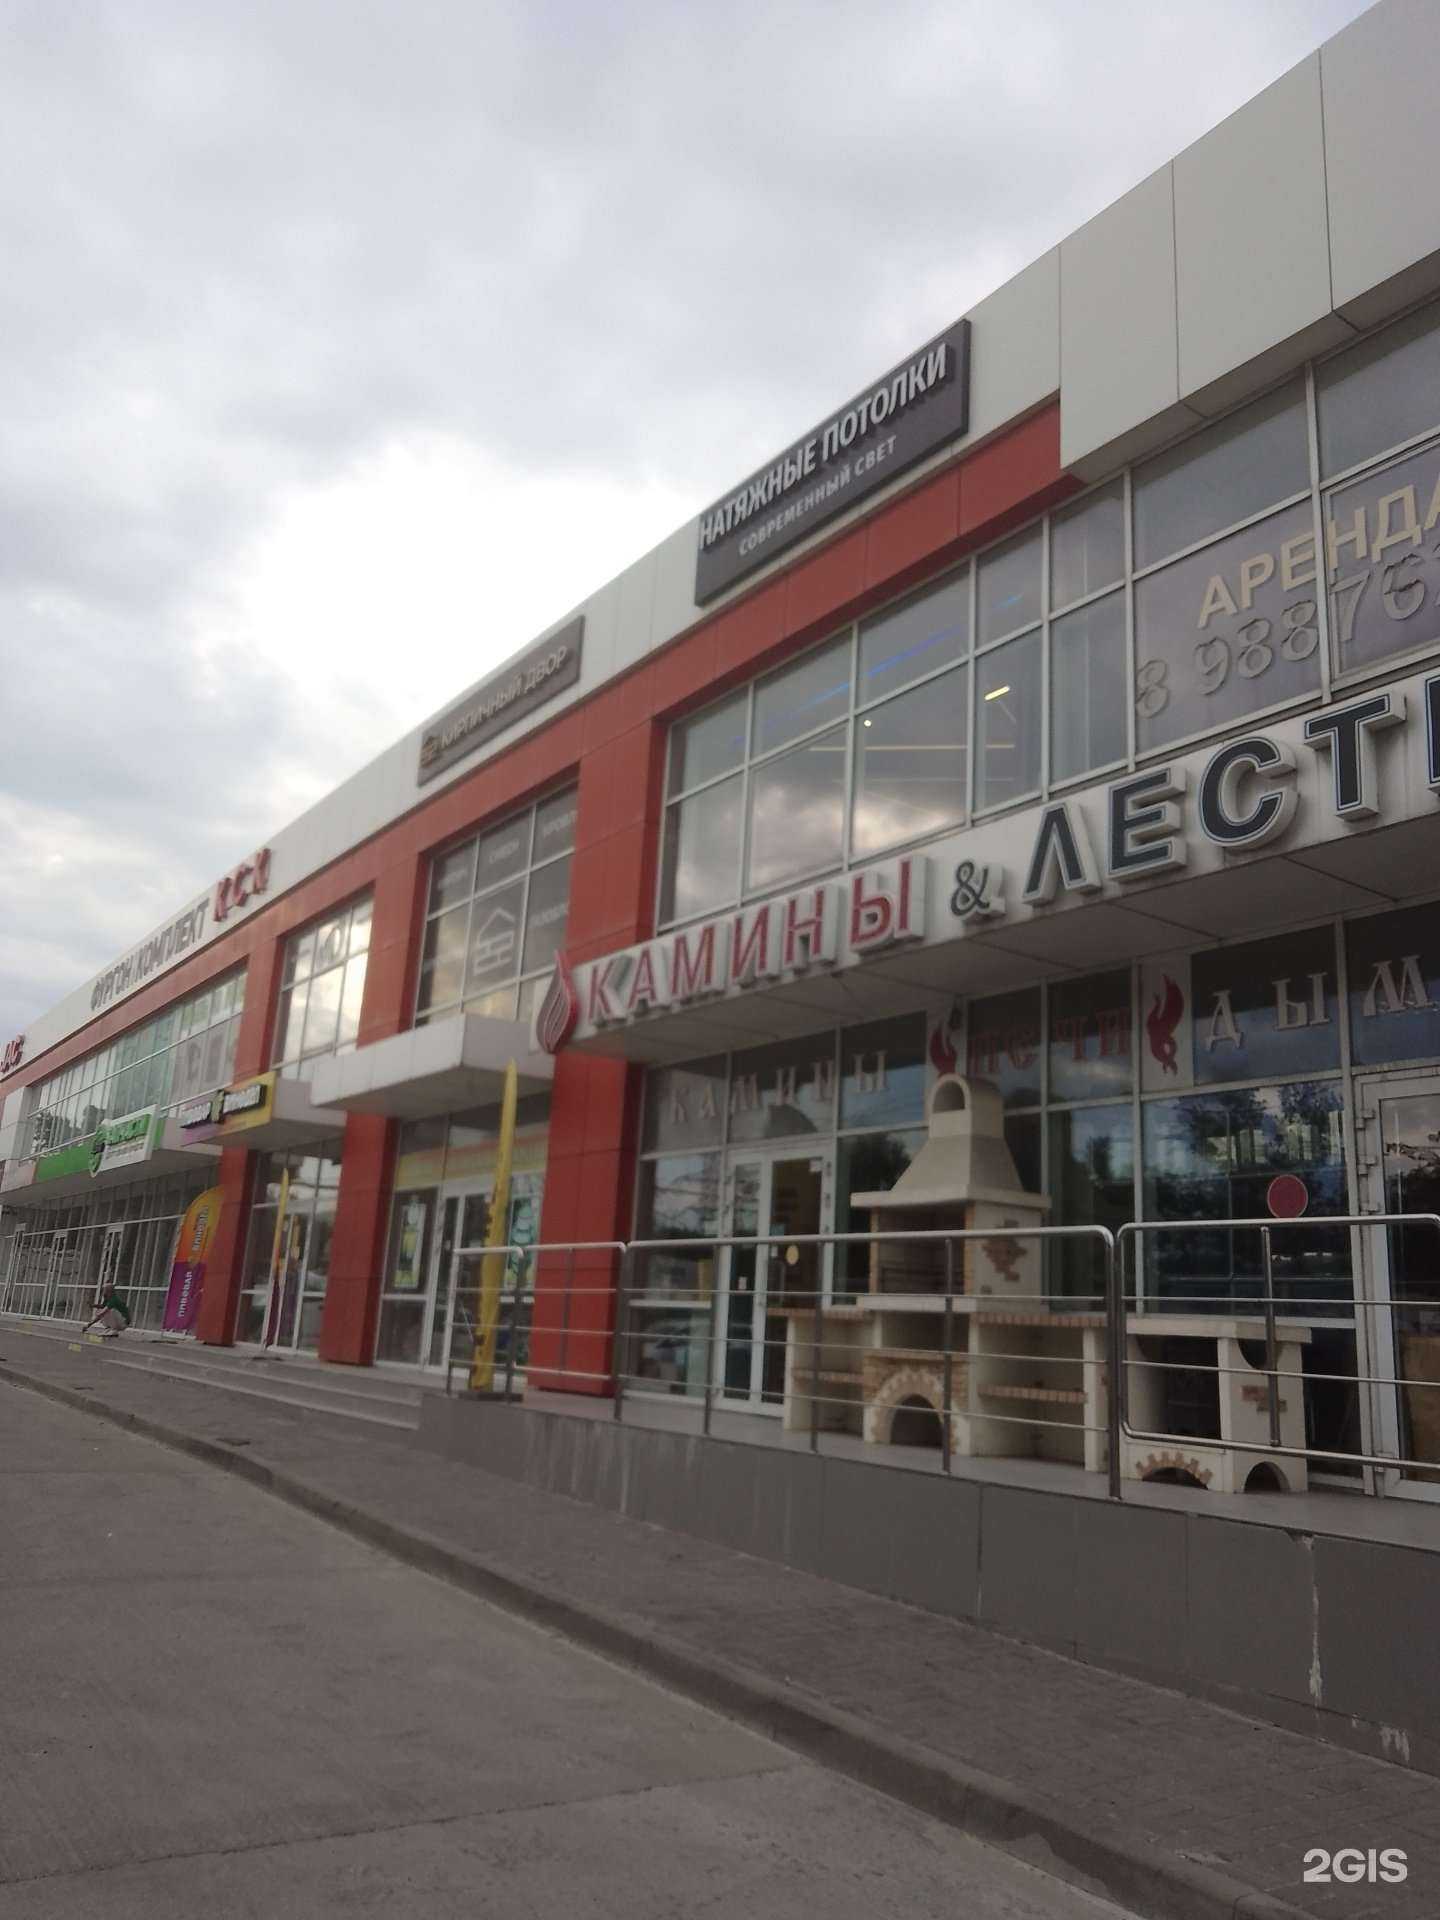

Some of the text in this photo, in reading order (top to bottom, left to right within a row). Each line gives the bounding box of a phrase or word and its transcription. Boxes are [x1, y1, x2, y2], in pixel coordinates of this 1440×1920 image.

[698, 342, 949, 551] НАТЯЖНЫЕ ПОТОЛКИ
[738, 434, 898, 557] СОВРЕМЕННЫЙ СВЕТ
[523, 645, 568, 695] ДВОР
[1135, 540, 1440, 719] 8 98876
[588, 673, 1440, 1023] КАМИНЫ & ЛЕСТ
[135, 897, 210, 980] КОМПЛЕКТ
[670, 1048, 889, 1125] КАМИНЫ
